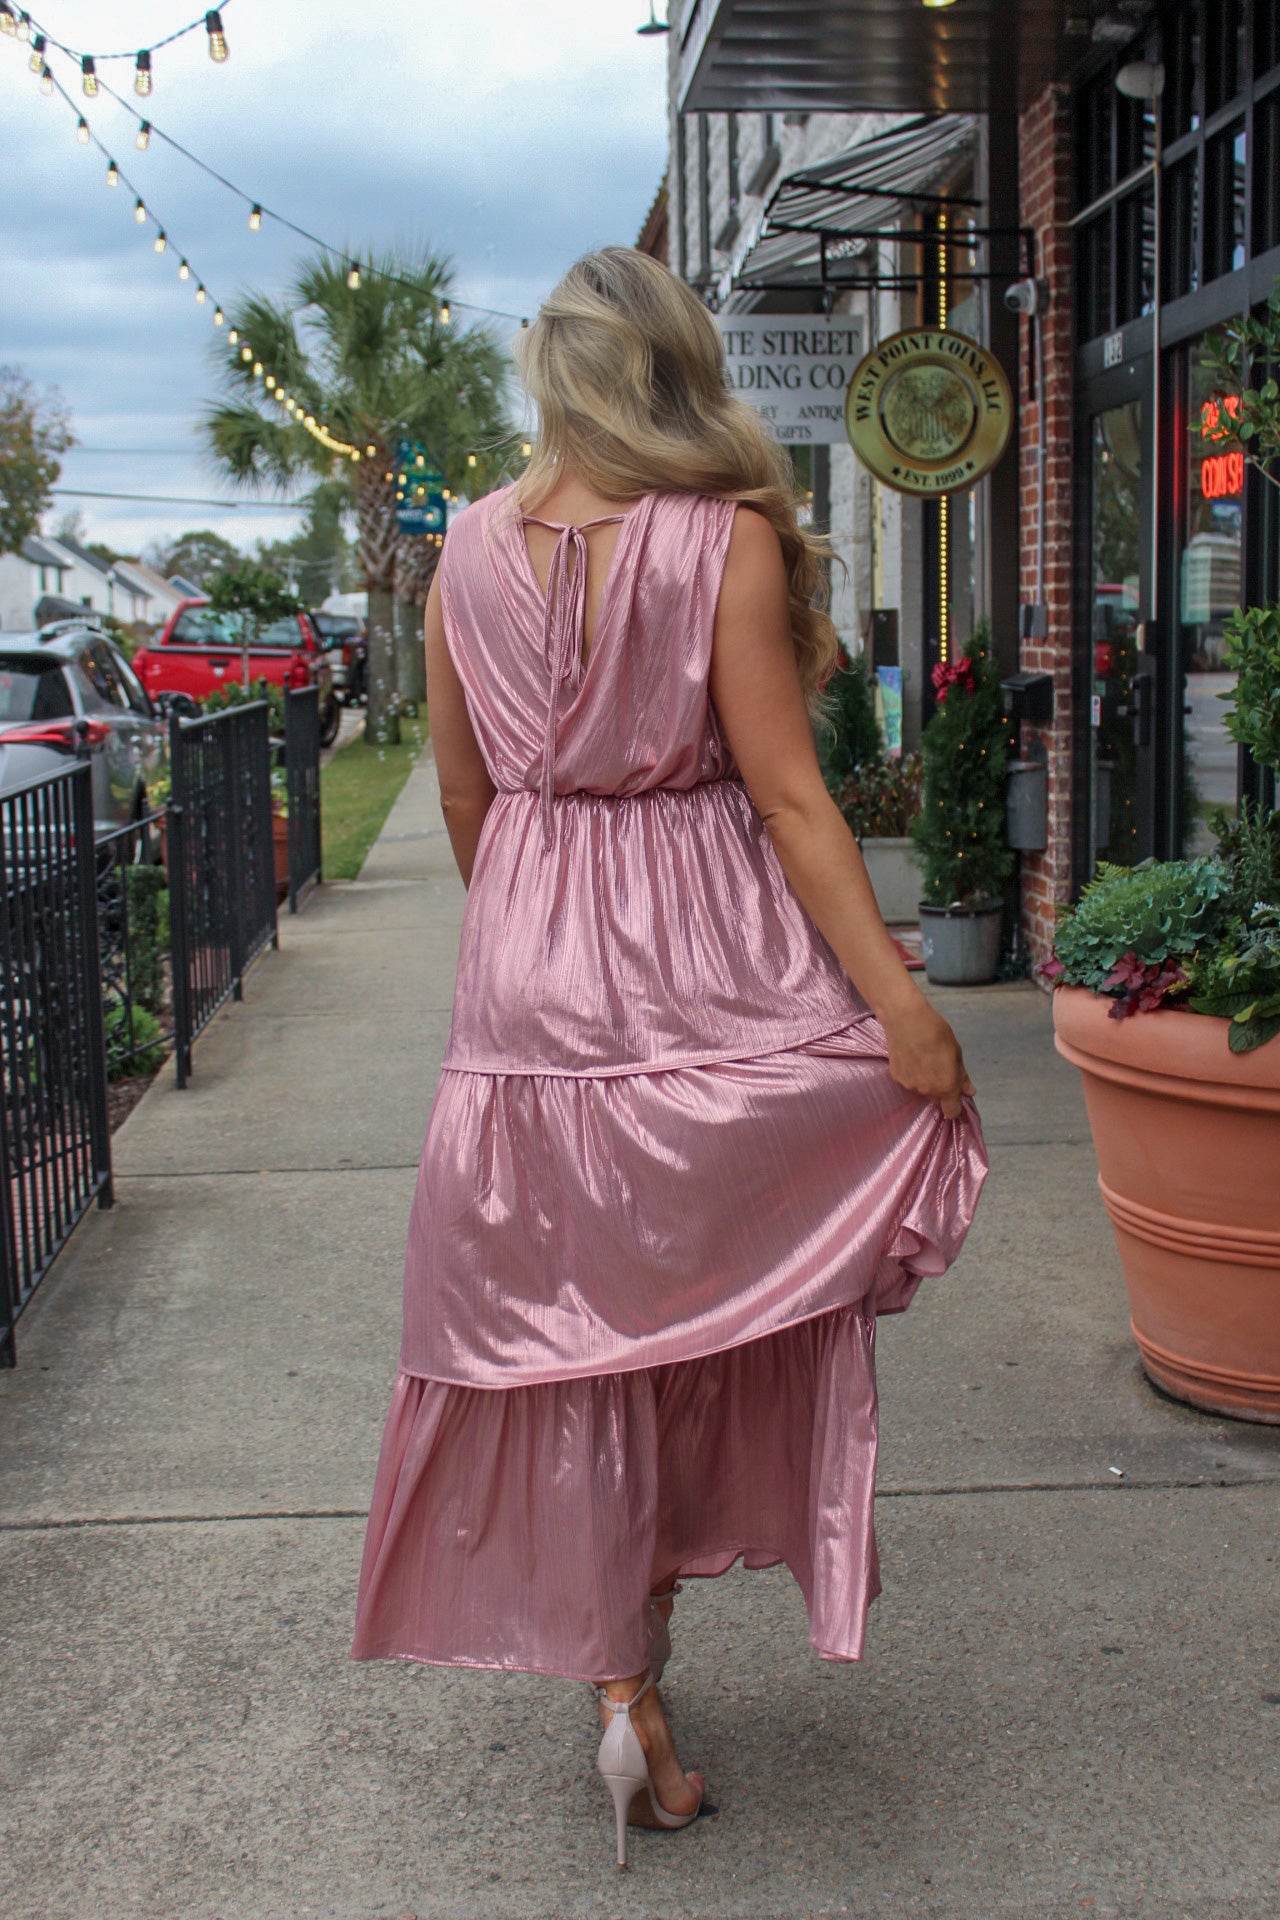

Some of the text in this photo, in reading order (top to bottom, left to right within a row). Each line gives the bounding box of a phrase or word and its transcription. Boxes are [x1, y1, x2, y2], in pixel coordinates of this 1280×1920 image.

[762, 330, 859, 355] STREET
[856, 365, 880, 421] WEST
[878, 334, 933, 367] POINT
[982, 379, 1001, 413] LLC
[776, 425, 813, 439] GIFTS
